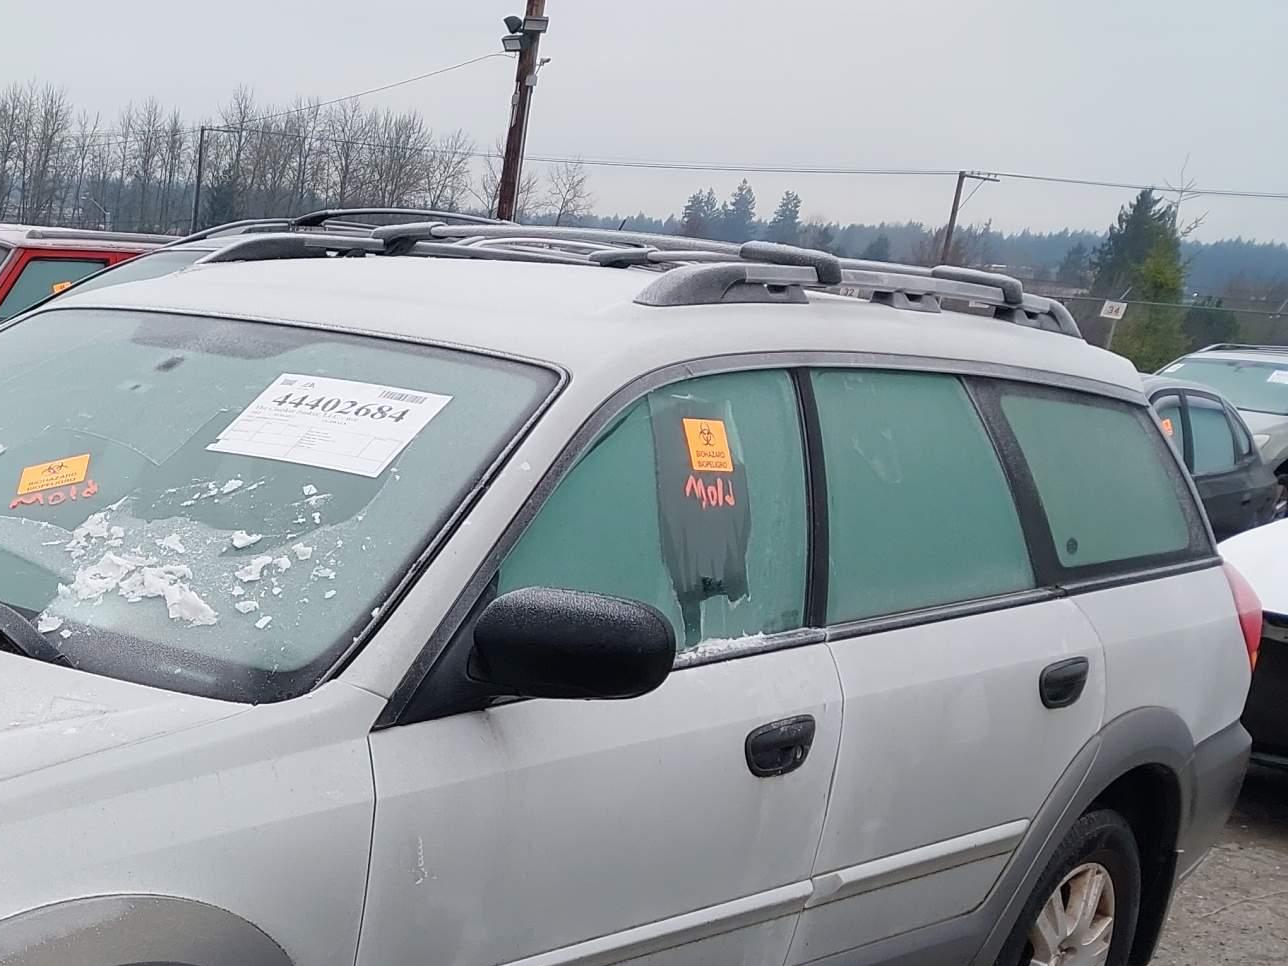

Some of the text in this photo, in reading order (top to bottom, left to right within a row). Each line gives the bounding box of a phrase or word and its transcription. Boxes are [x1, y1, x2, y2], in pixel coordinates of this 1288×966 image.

[272, 393, 411, 423] 44402684
[696, 450, 726, 459] BIOHAZARD
[685, 474, 736, 510] Mold
